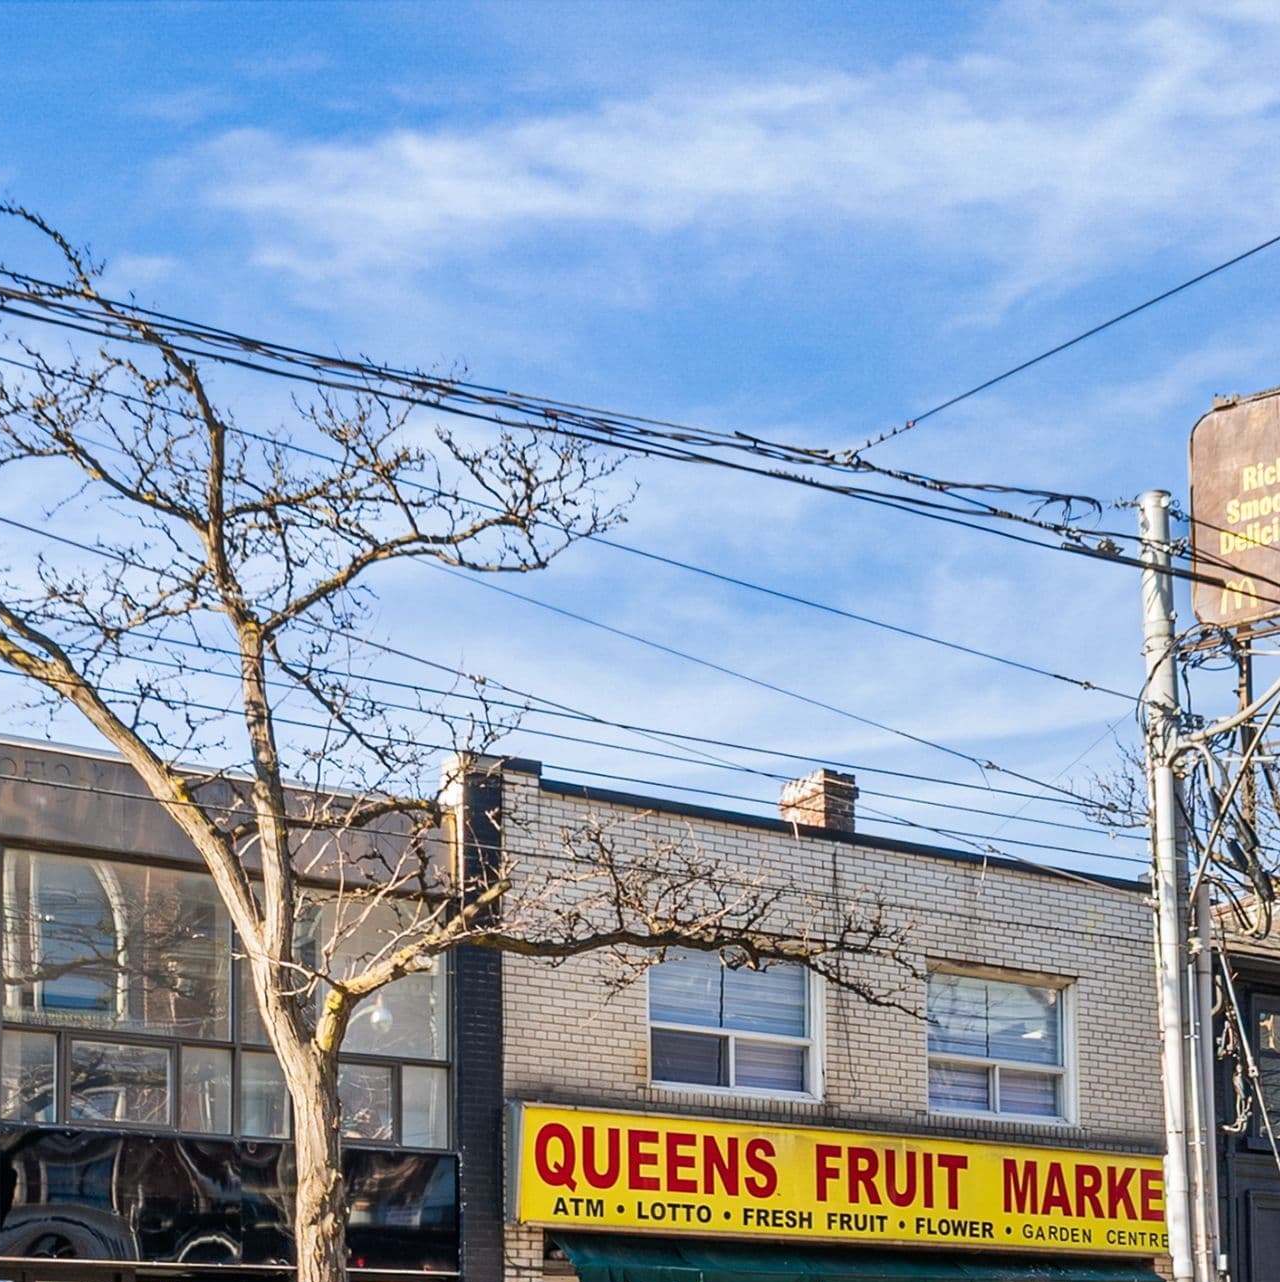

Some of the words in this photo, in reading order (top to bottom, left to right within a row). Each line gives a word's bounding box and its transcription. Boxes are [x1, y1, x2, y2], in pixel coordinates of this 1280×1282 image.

[533, 1122, 779, 1200] QUEENS
[815, 1144, 969, 1211] FRUIT
[1002, 1158, 1166, 1222] MARKE
[552, 1197, 605, 1217] ATM
[636, 1201, 712, 1223] LOTTO
[742, 1208, 813, 1230] FRESH
[827, 1212, 888, 1233] FRUIT
[915, 1217, 994, 1239] FLOWER
[1022, 1223, 1092, 1244] GARDEN
[1106, 1229, 1169, 1249] CENTRE
